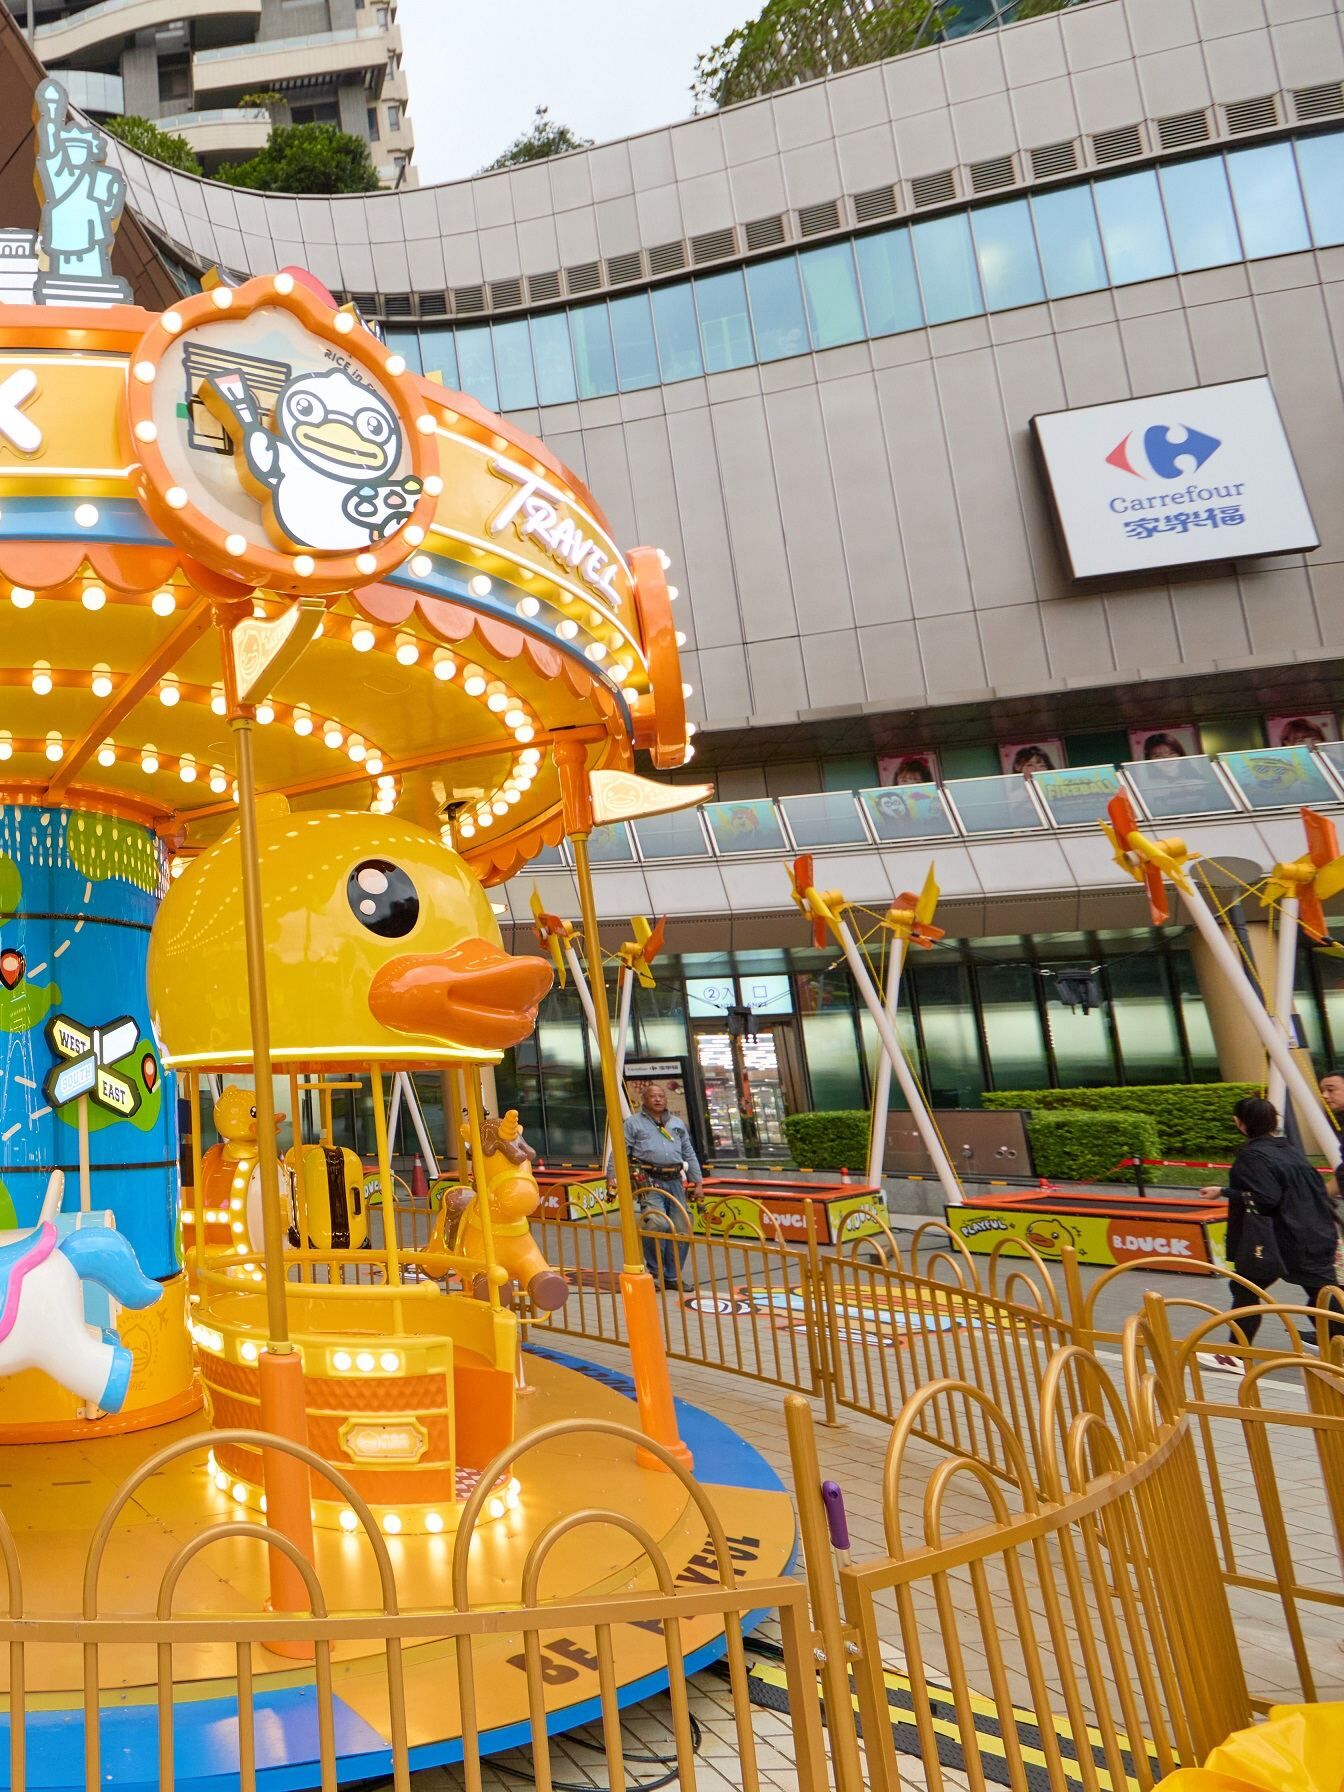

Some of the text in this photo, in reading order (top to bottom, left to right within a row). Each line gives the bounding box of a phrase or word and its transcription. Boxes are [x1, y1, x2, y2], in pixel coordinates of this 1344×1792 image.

[324, 348, 352, 371] RICE
[1109, 483, 1245, 514] Carrefour
[491, 454, 622, 606] TRAVEL
[1123, 504, 1246, 540] 家樂福
[59, 1029, 86, 1054] WEST
[62, 1065, 92, 1091] SOUTH
[102, 1080, 126, 1105] EAST
[960, 1220, 1008, 1238] PLAYFUL
[1112, 1235, 1192, 1256] B.DUCK
[506, 1637, 599, 1686] BE
